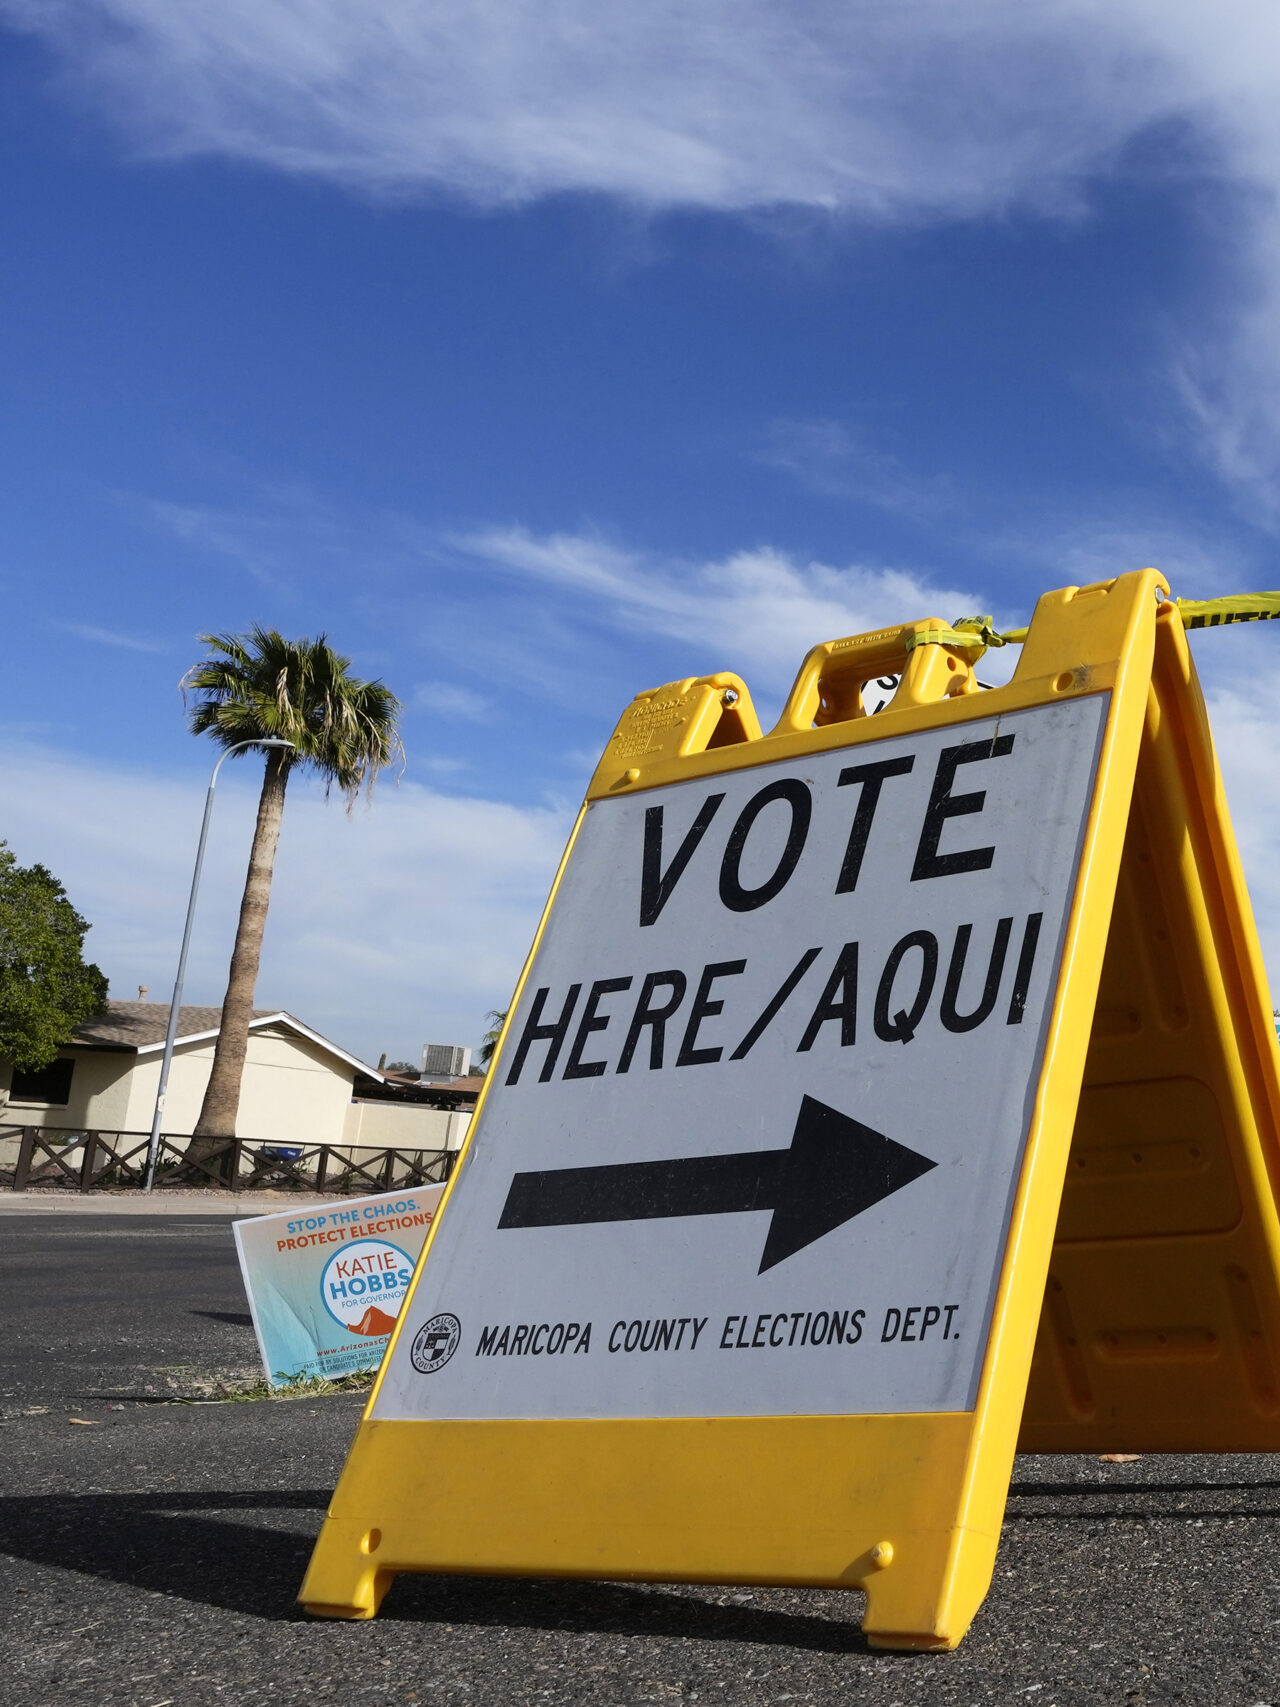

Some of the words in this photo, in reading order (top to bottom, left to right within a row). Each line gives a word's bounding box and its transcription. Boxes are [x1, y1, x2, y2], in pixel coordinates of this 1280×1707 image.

[638, 733, 1016, 928] VOTE
[504, 911, 1044, 1087] HERE/AQUI
[277, 1228, 347, 1252] PROTECT
[350, 1212, 433, 1239] ELECTIONS
[287, 1216, 327, 1234] STOP
[329, 1209, 361, 1226] THE
[363, 1199, 421, 1219] CHAOS.
[336, 1251, 398, 1279] KATIE
[329, 1268, 411, 1300] HOBBS
[341, 1298, 359, 1309] FOR
[475, 1322, 593, 1357] MARICOPA
[607, 1317, 709, 1354] COUNTY
[719, 1309, 866, 1349] ELECTIONS
[880, 1304, 960, 1343] DEPT.
[415, 1355, 446, 1370] COUNTY
